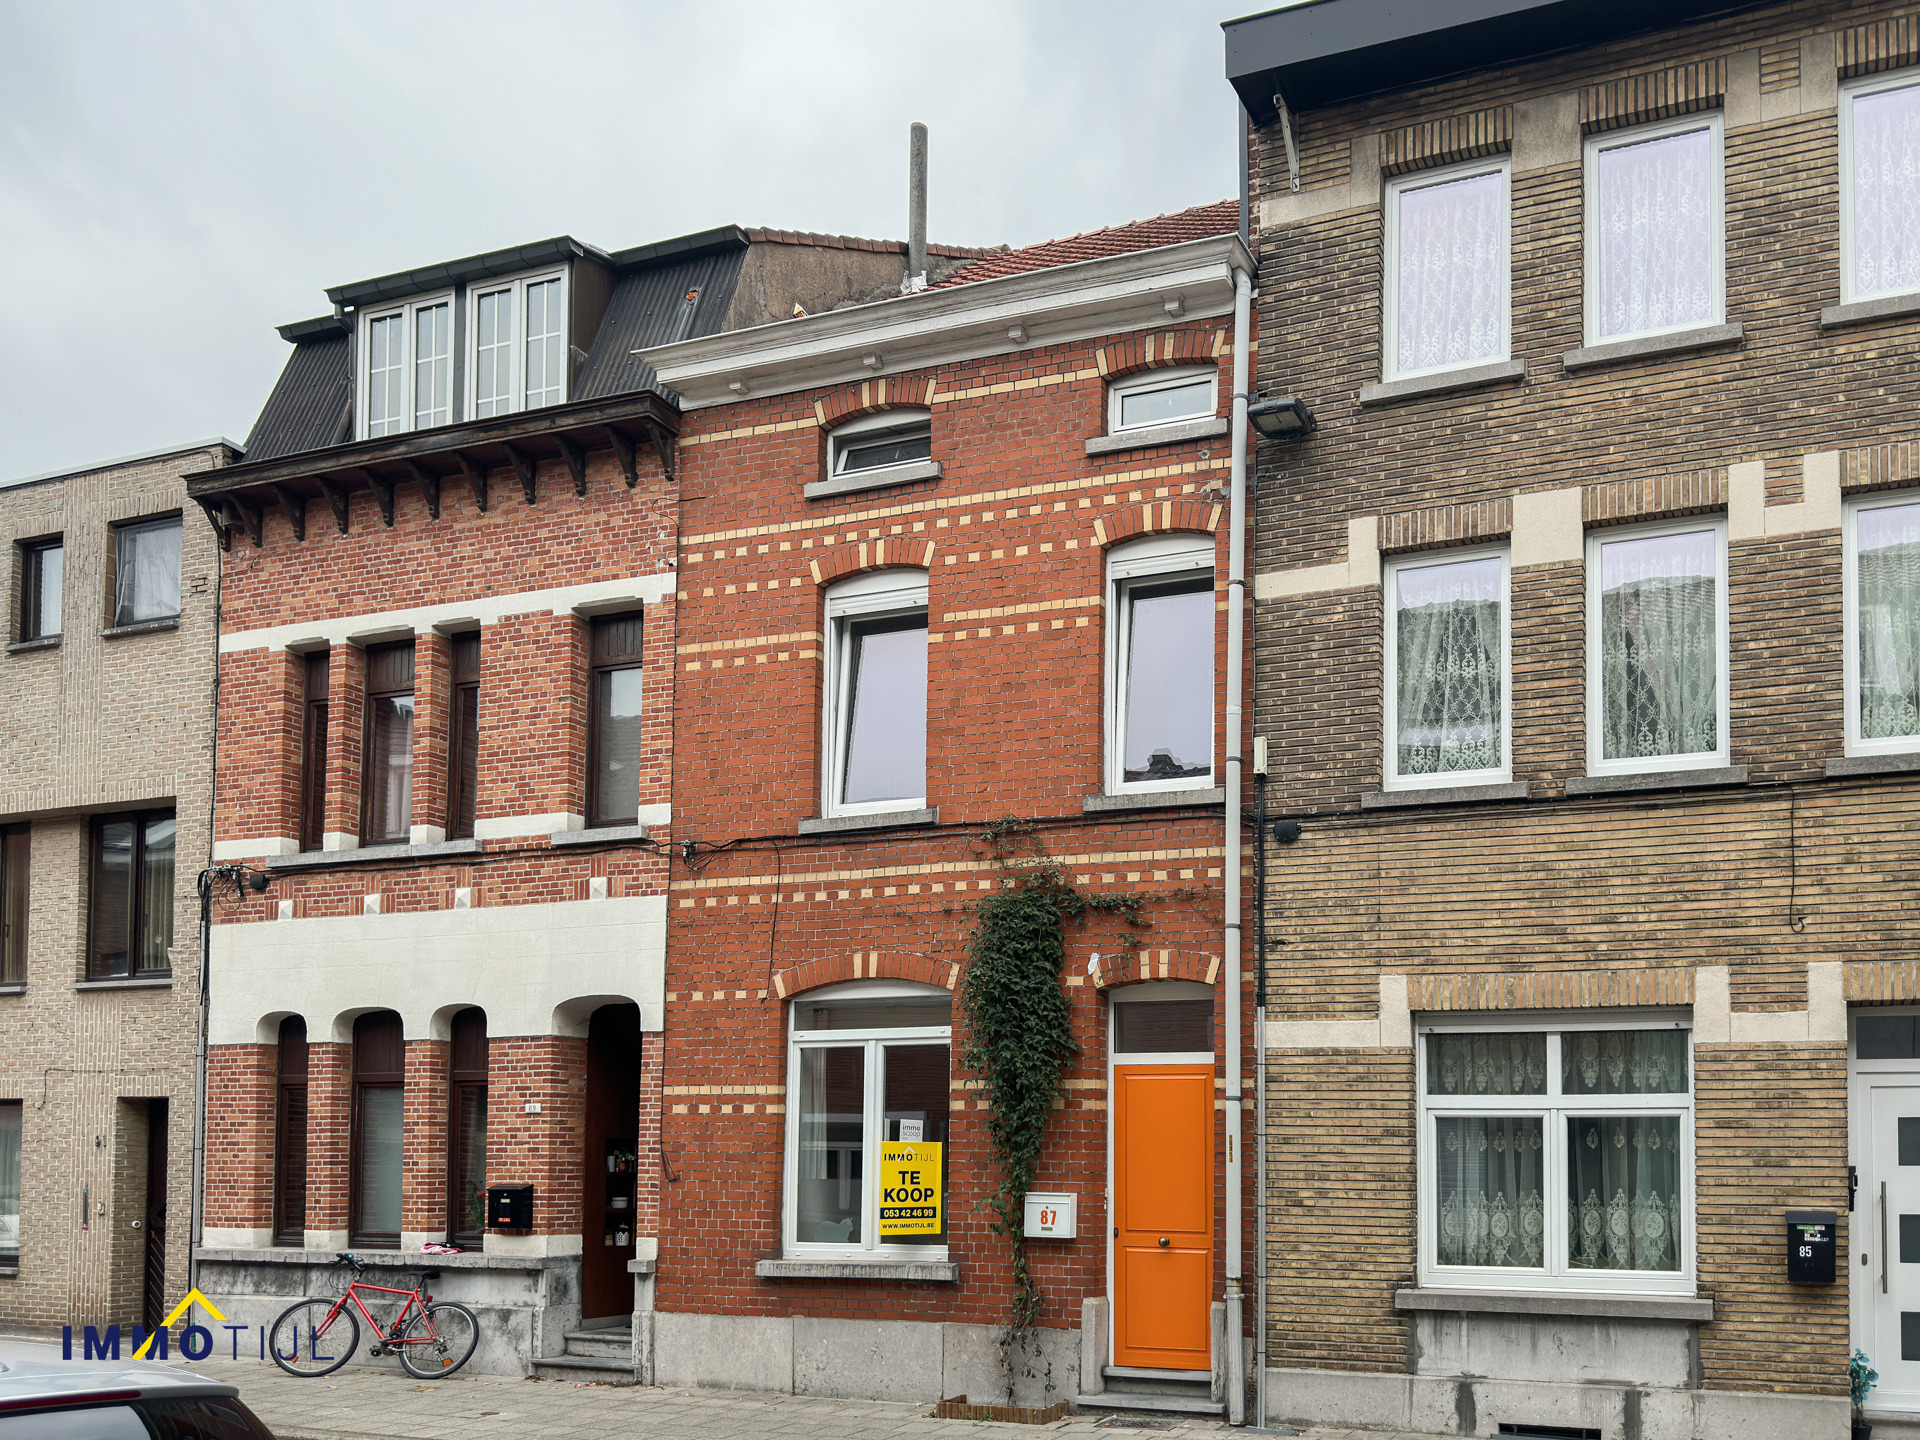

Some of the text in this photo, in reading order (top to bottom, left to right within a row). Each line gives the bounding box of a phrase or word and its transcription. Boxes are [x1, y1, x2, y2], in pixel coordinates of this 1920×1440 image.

[528, 1104, 537, 1112] 89
[884, 1153, 935, 1162] IMMOTIJL
[898, 1170, 921, 1185] TE
[883, 1187, 935, 1203] KOOP
[883, 1208, 934, 1218] 053 42 46 99
[1040, 1210, 1057, 1225] 87
[1799, 1245, 1812, 1257] 85
